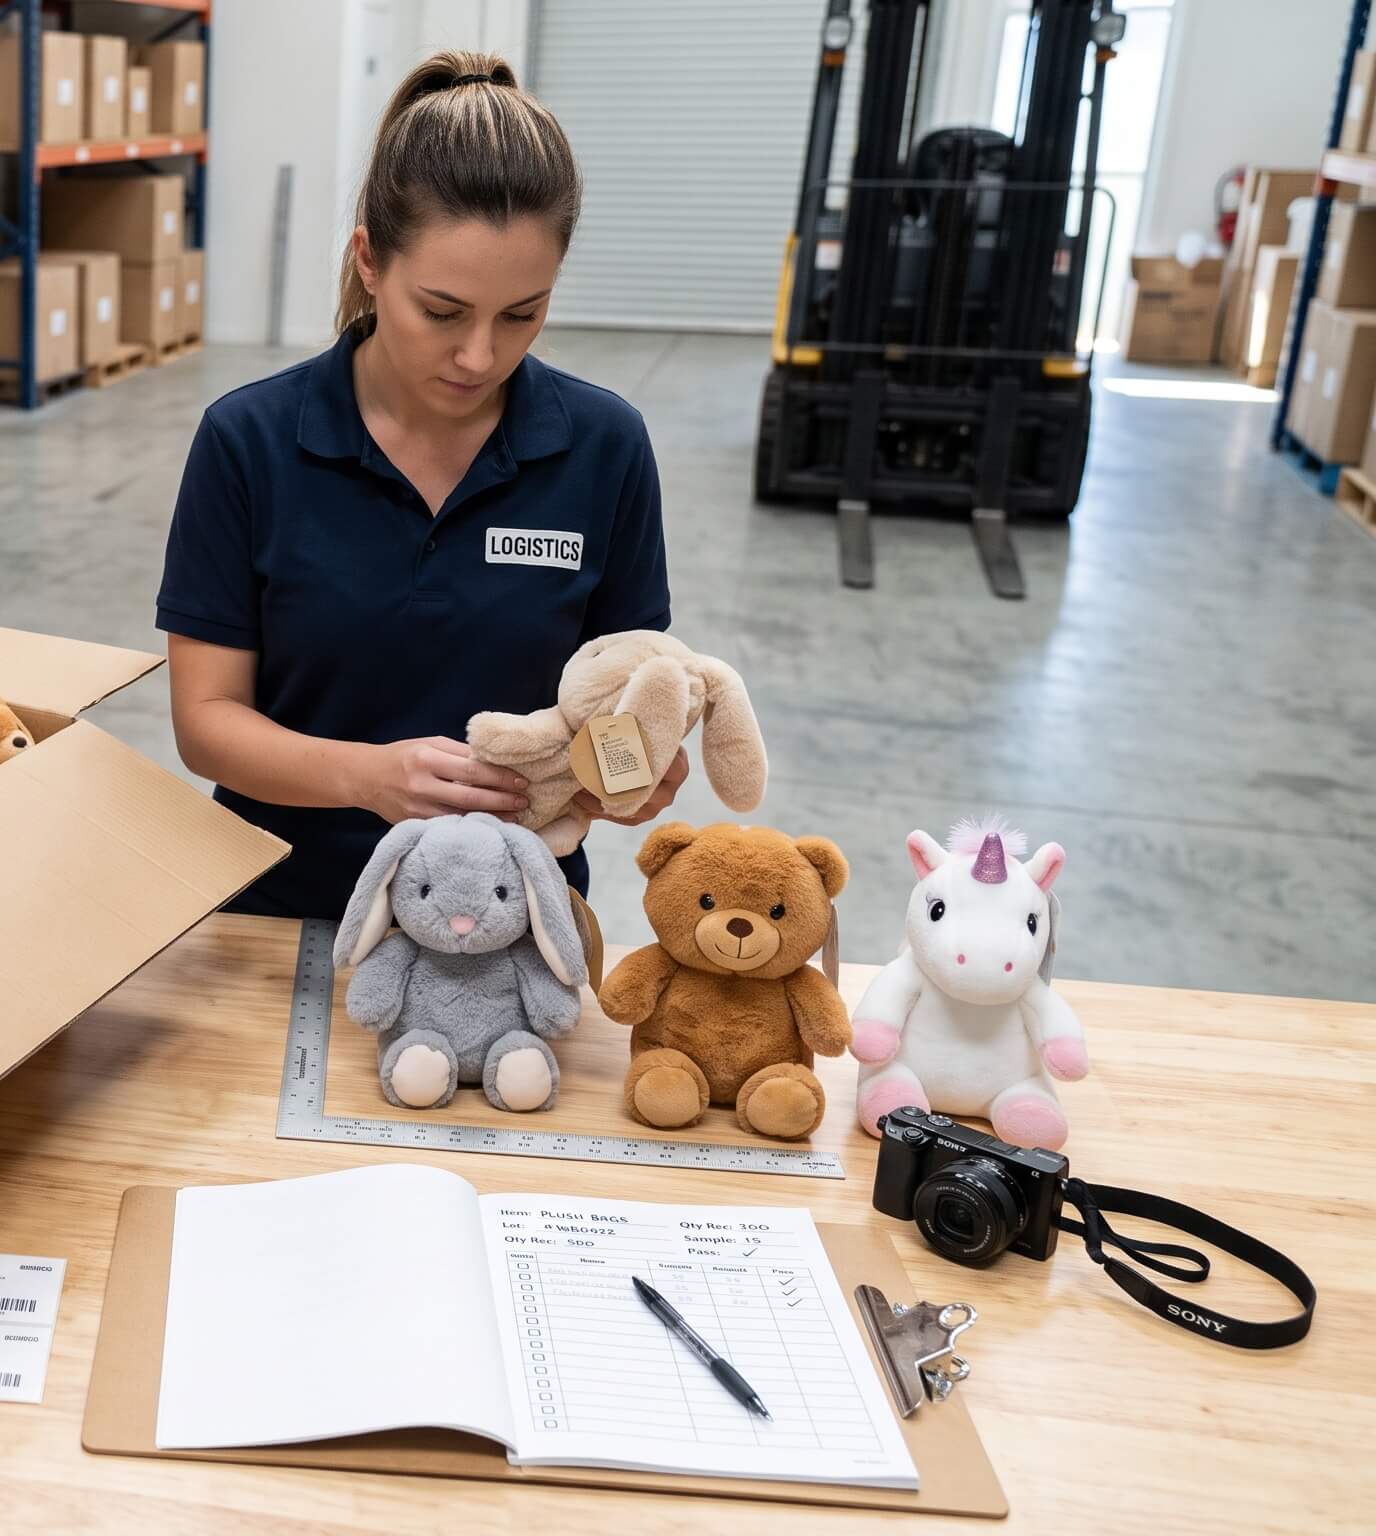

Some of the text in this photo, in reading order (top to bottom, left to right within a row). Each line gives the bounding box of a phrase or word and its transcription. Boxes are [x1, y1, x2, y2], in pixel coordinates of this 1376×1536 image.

[490, 535, 580, 562] LOGISTICS
[500, 1209, 629, 1223] Item: PLUSH BAGS
[502, 1221, 525, 1229] Lot:
[679, 1221, 770, 1231] Qty Rec: 300
[504, 1235, 527, 1244] Qty
[530, 1236, 557, 1245] Rec:
[683, 1235, 737, 1245] Sample:
[687, 1248, 721, 1256] Pass:
[1167, 1303, 1228, 1334] SONY
